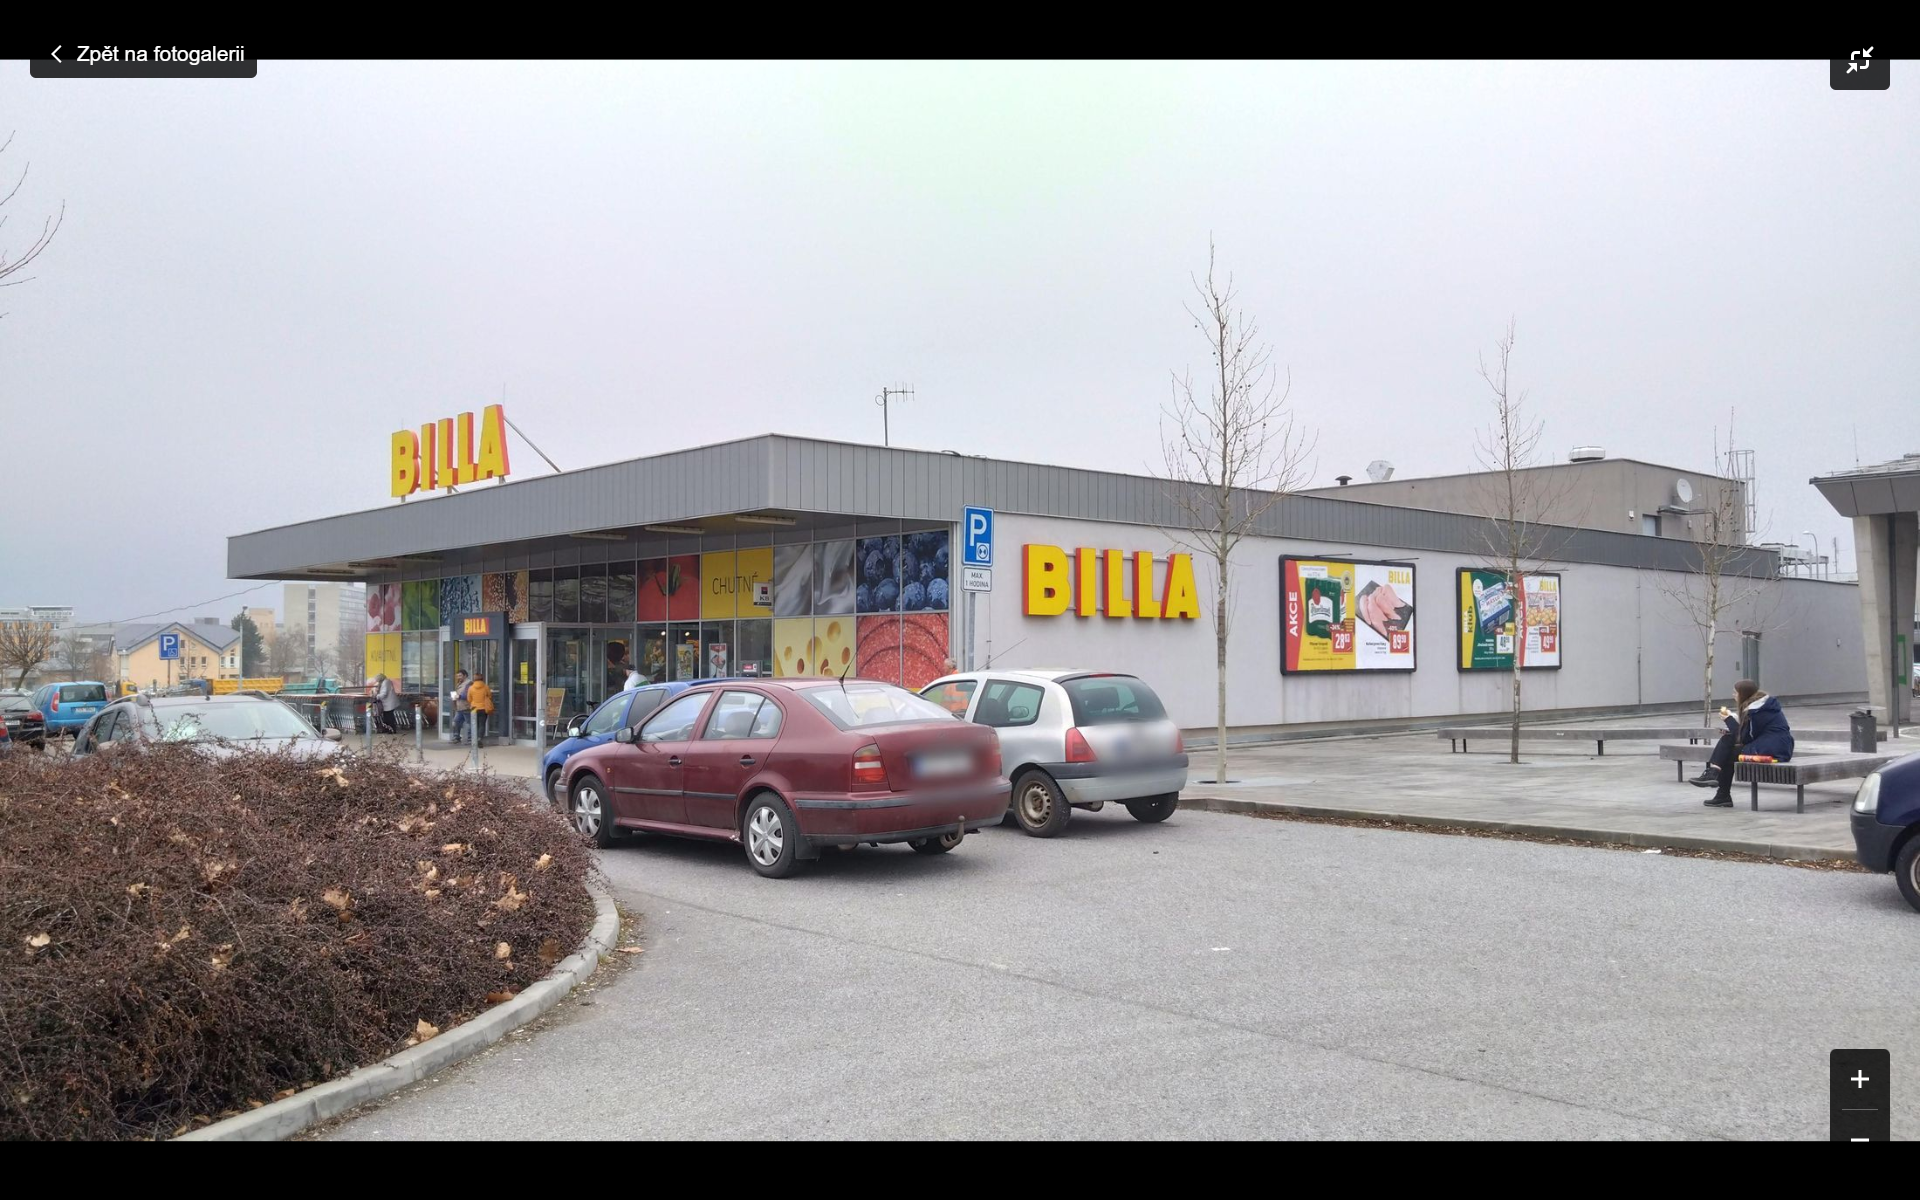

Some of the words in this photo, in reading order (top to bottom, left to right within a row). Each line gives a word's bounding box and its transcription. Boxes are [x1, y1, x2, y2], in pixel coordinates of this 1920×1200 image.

[391, 404, 510, 498] BILLA
[969, 513, 987, 547] P
[969, 580, 989, 588] HODINA
[1022, 543, 1201, 619] BILLA
[1388, 570, 1411, 585] BILLA
[1539, 579, 1557, 592] BILLA
[1288, 591, 1298, 638] AKCE
[464, 618, 487, 634] BILLA
[163, 636, 175, 651] P
